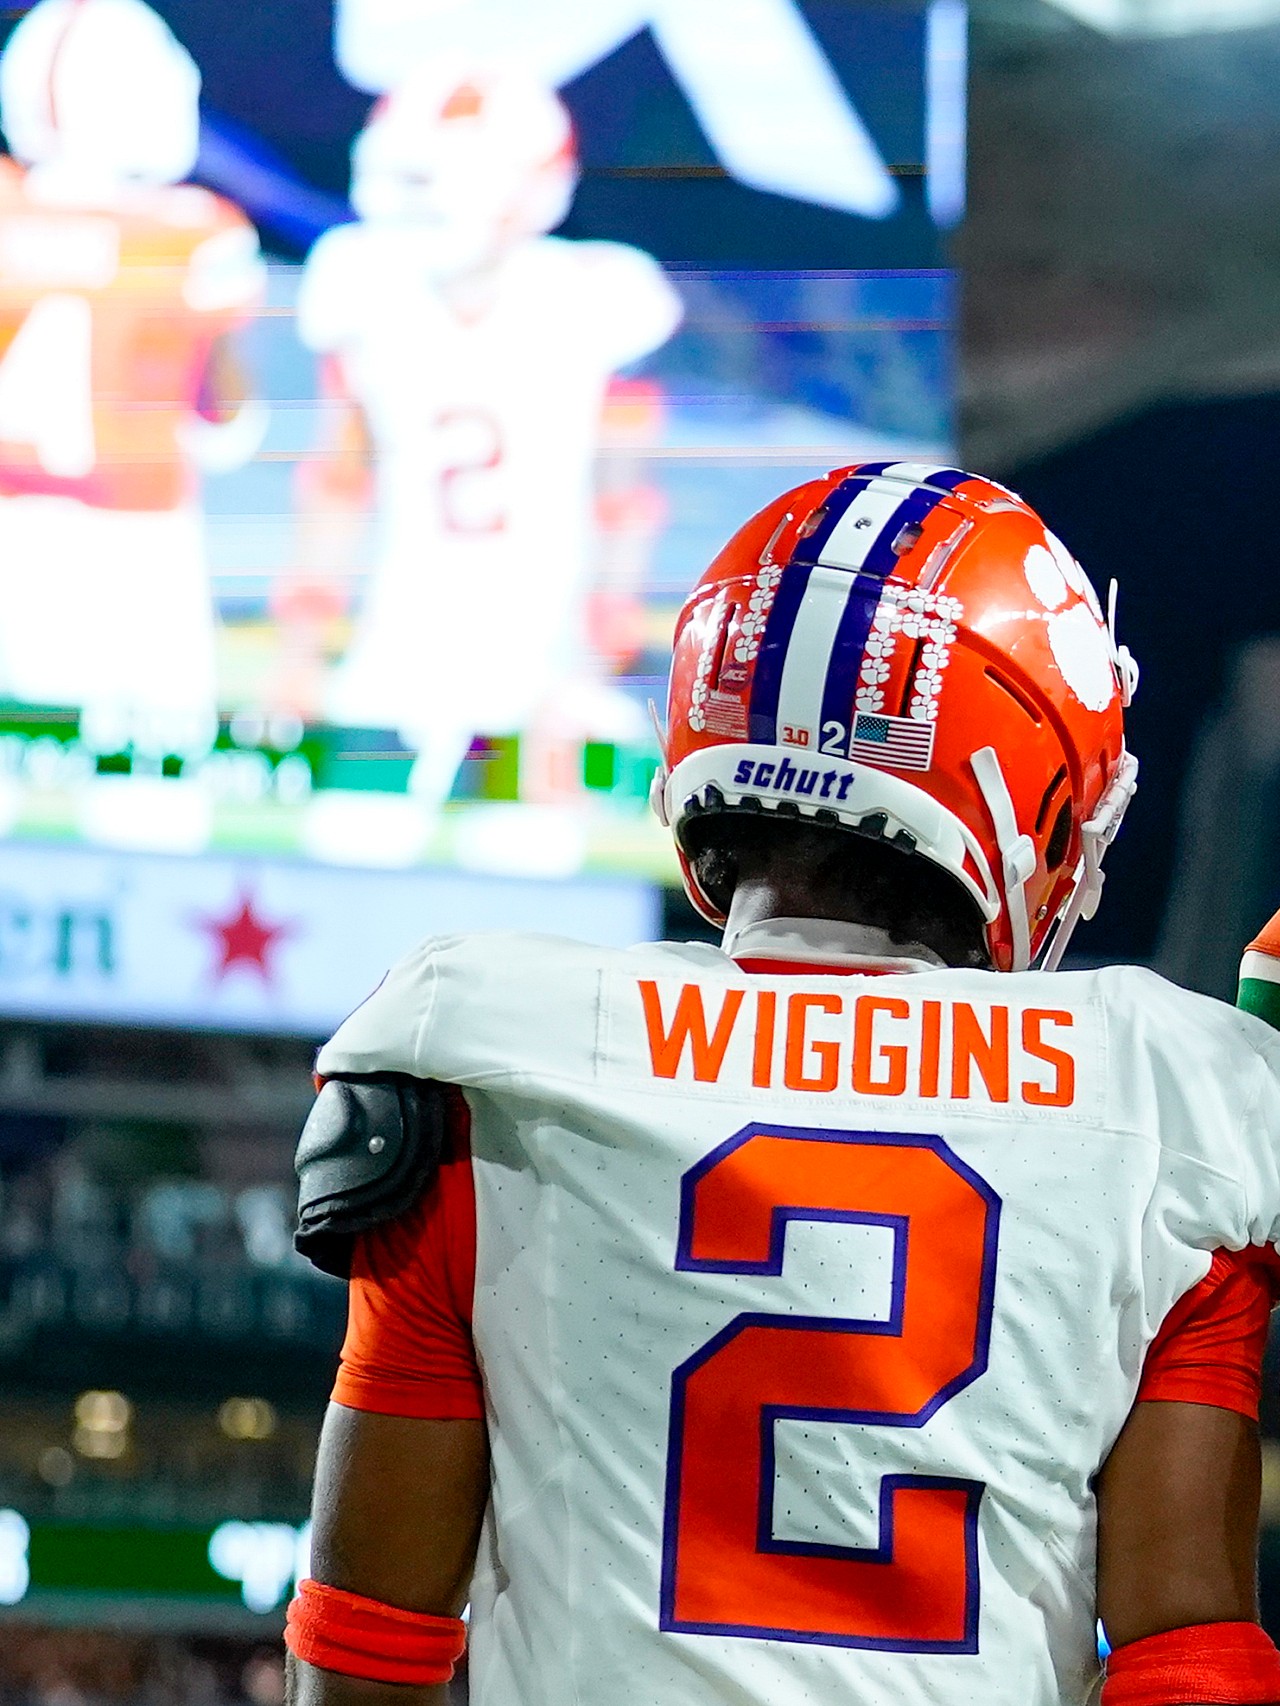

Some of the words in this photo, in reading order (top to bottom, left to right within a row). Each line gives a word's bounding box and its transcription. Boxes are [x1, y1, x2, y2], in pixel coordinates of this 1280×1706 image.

[733, 757, 855, 801] schutt
[820, 720, 846, 756] 2
[638, 980, 1075, 1107] WIGGINS
[659, 1122, 1002, 1655] 2
